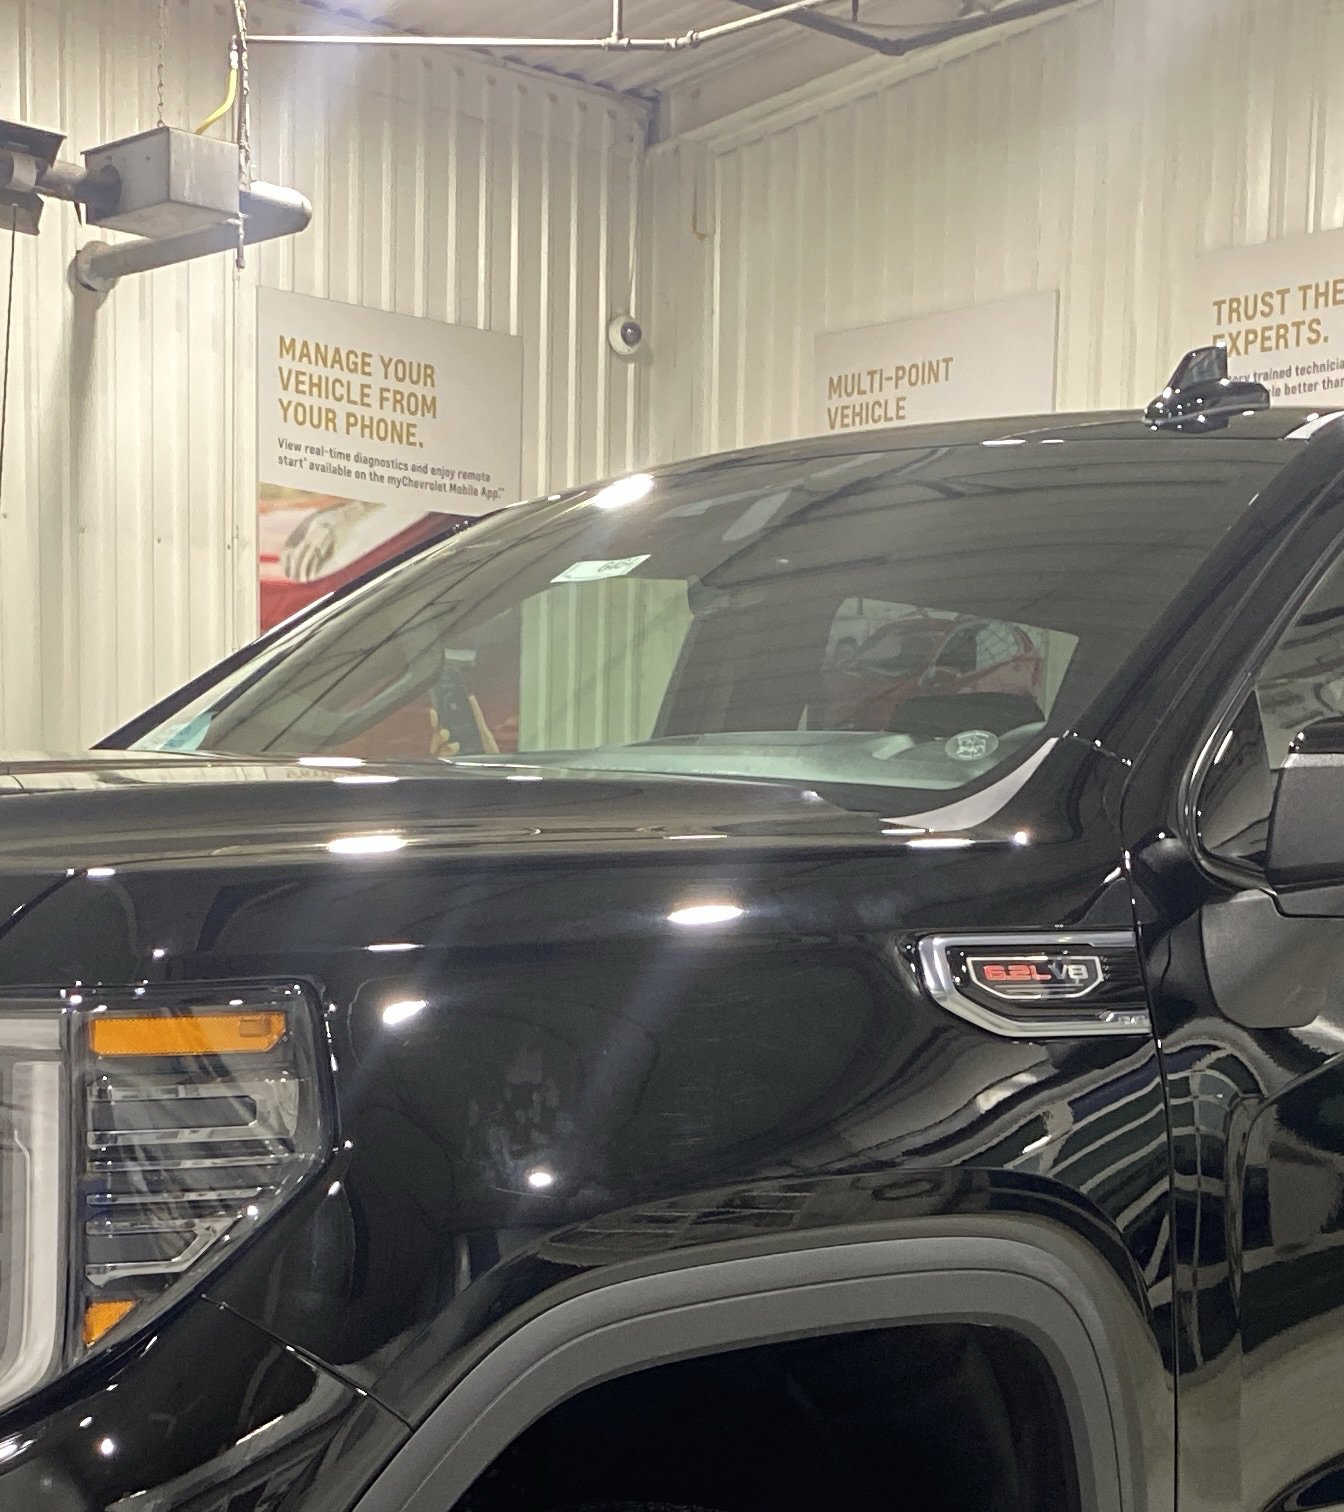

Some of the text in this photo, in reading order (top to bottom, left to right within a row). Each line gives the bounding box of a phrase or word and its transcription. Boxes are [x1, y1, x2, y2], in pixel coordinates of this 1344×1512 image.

[1212, 287, 1291, 326] TRUST
[279, 334, 436, 389] MANAGE YOUR
[828, 356, 954, 401] MULTI-POINT
[1253, 366, 1291, 381] trained
[278, 366, 437, 420] VEHICLE FROM
[1284, 379, 1319, 396] better
[278, 398, 424, 449] YOUR PHONE.
[827, 396, 906, 431] VEHICLE
[278, 437, 491, 482] View real-time diagnostics and enjoy remote
[309, 461, 352, 478] available
[355, 470, 367, 480] on
[369, 471, 385, 483] the
[387, 475, 447, 493] myChevrolet
[449, 482, 479, 497] Mobile
[1048, 962, 1089, 981] V8
